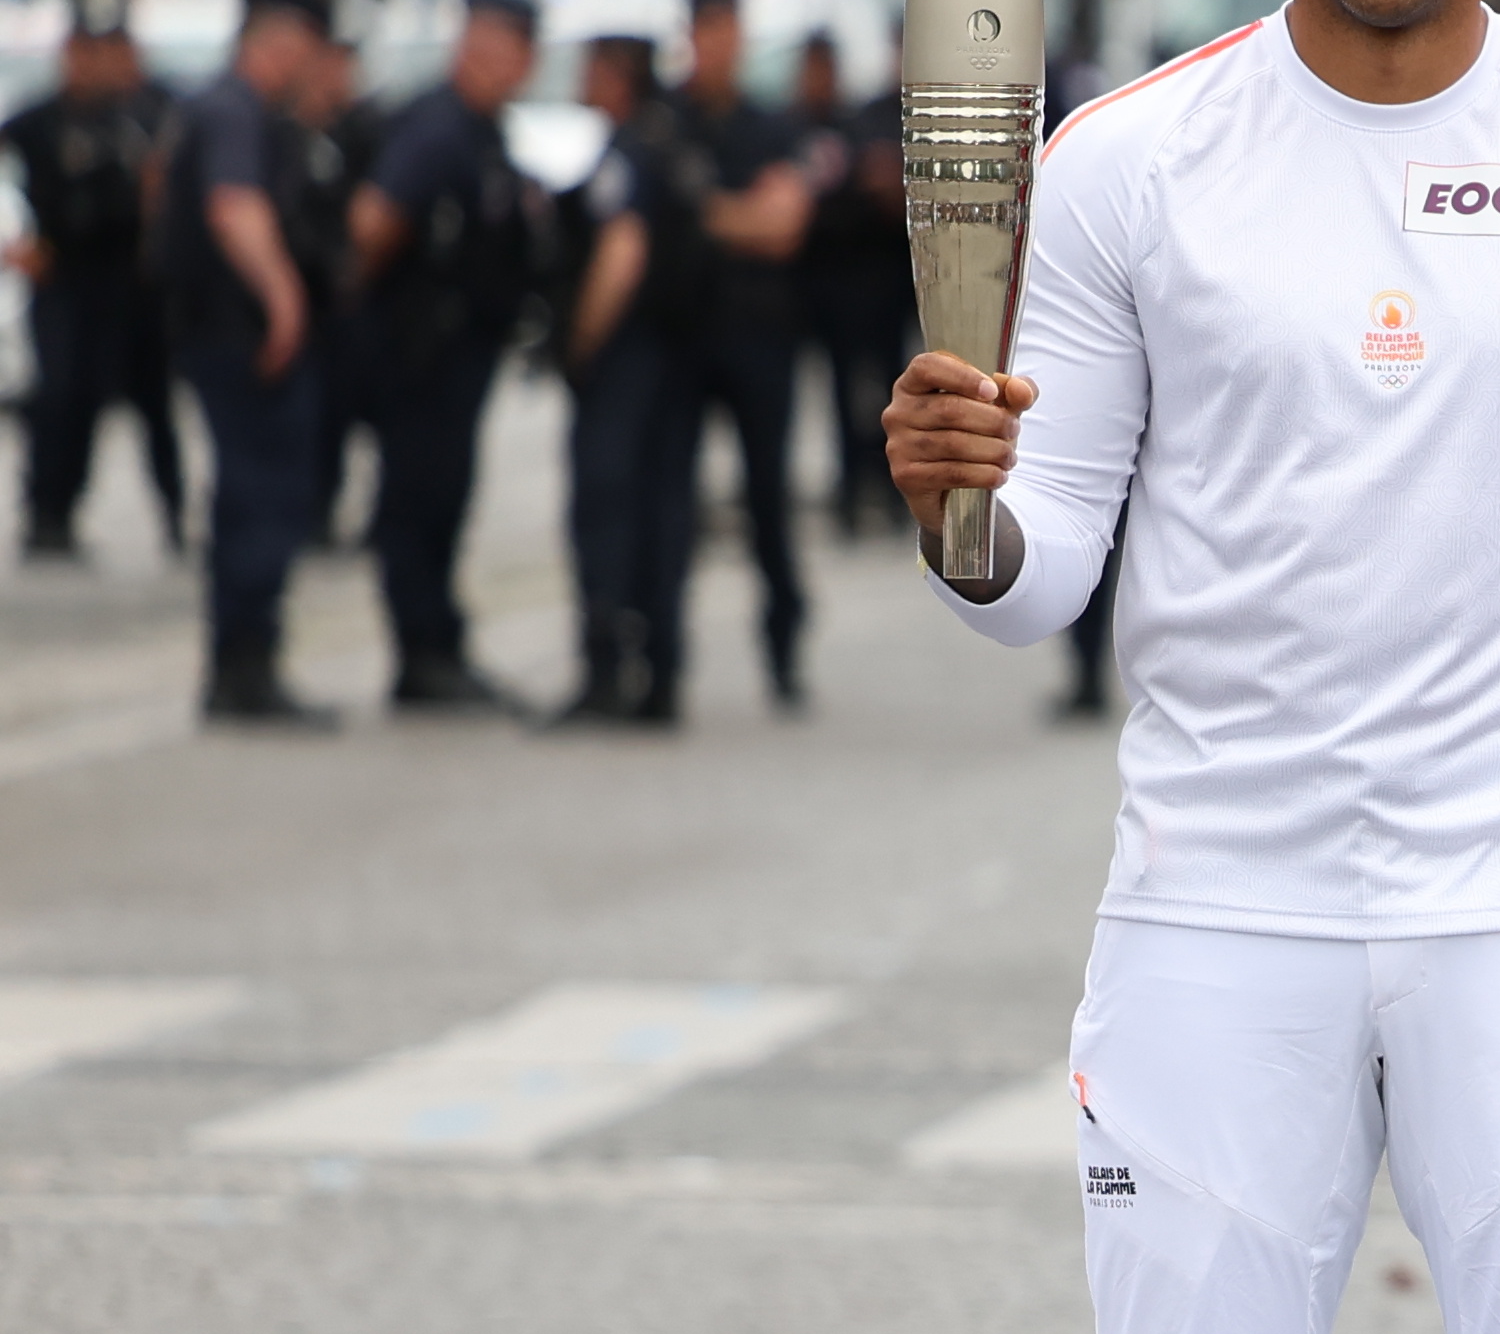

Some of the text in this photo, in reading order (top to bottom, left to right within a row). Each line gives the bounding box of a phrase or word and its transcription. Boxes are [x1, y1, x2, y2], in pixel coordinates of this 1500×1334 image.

[1365, 332, 1420, 342] RELAIS DE
[1361, 341, 1425, 352] LA FLAMME
[1361, 351, 1425, 361] OLYMPIQUE
[1088, 1166, 1130, 1180] RELAIS DE
[1086, 1180, 1136, 1195] LA FLAMME
[1090, 1198, 1134, 1208] PARIS 2024
